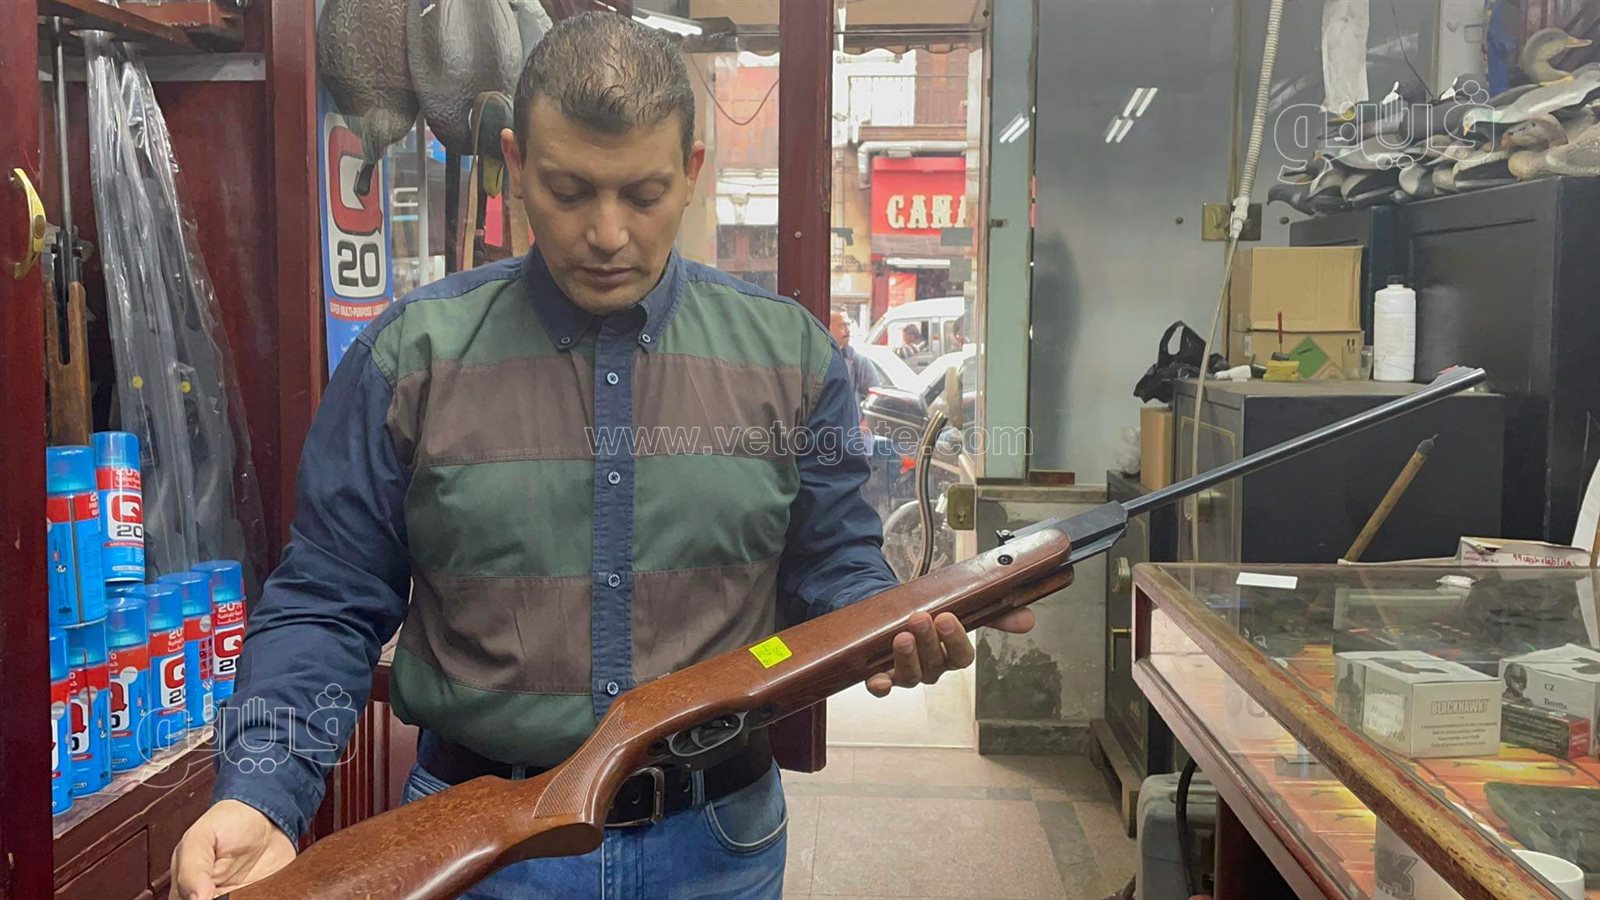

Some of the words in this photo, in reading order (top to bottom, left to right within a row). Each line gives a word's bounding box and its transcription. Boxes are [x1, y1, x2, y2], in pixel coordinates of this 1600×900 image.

[337, 240, 380, 288] 20
[112, 495, 142, 524] Q
[117, 524, 142, 538] 20
[215, 629, 244, 659] Q
